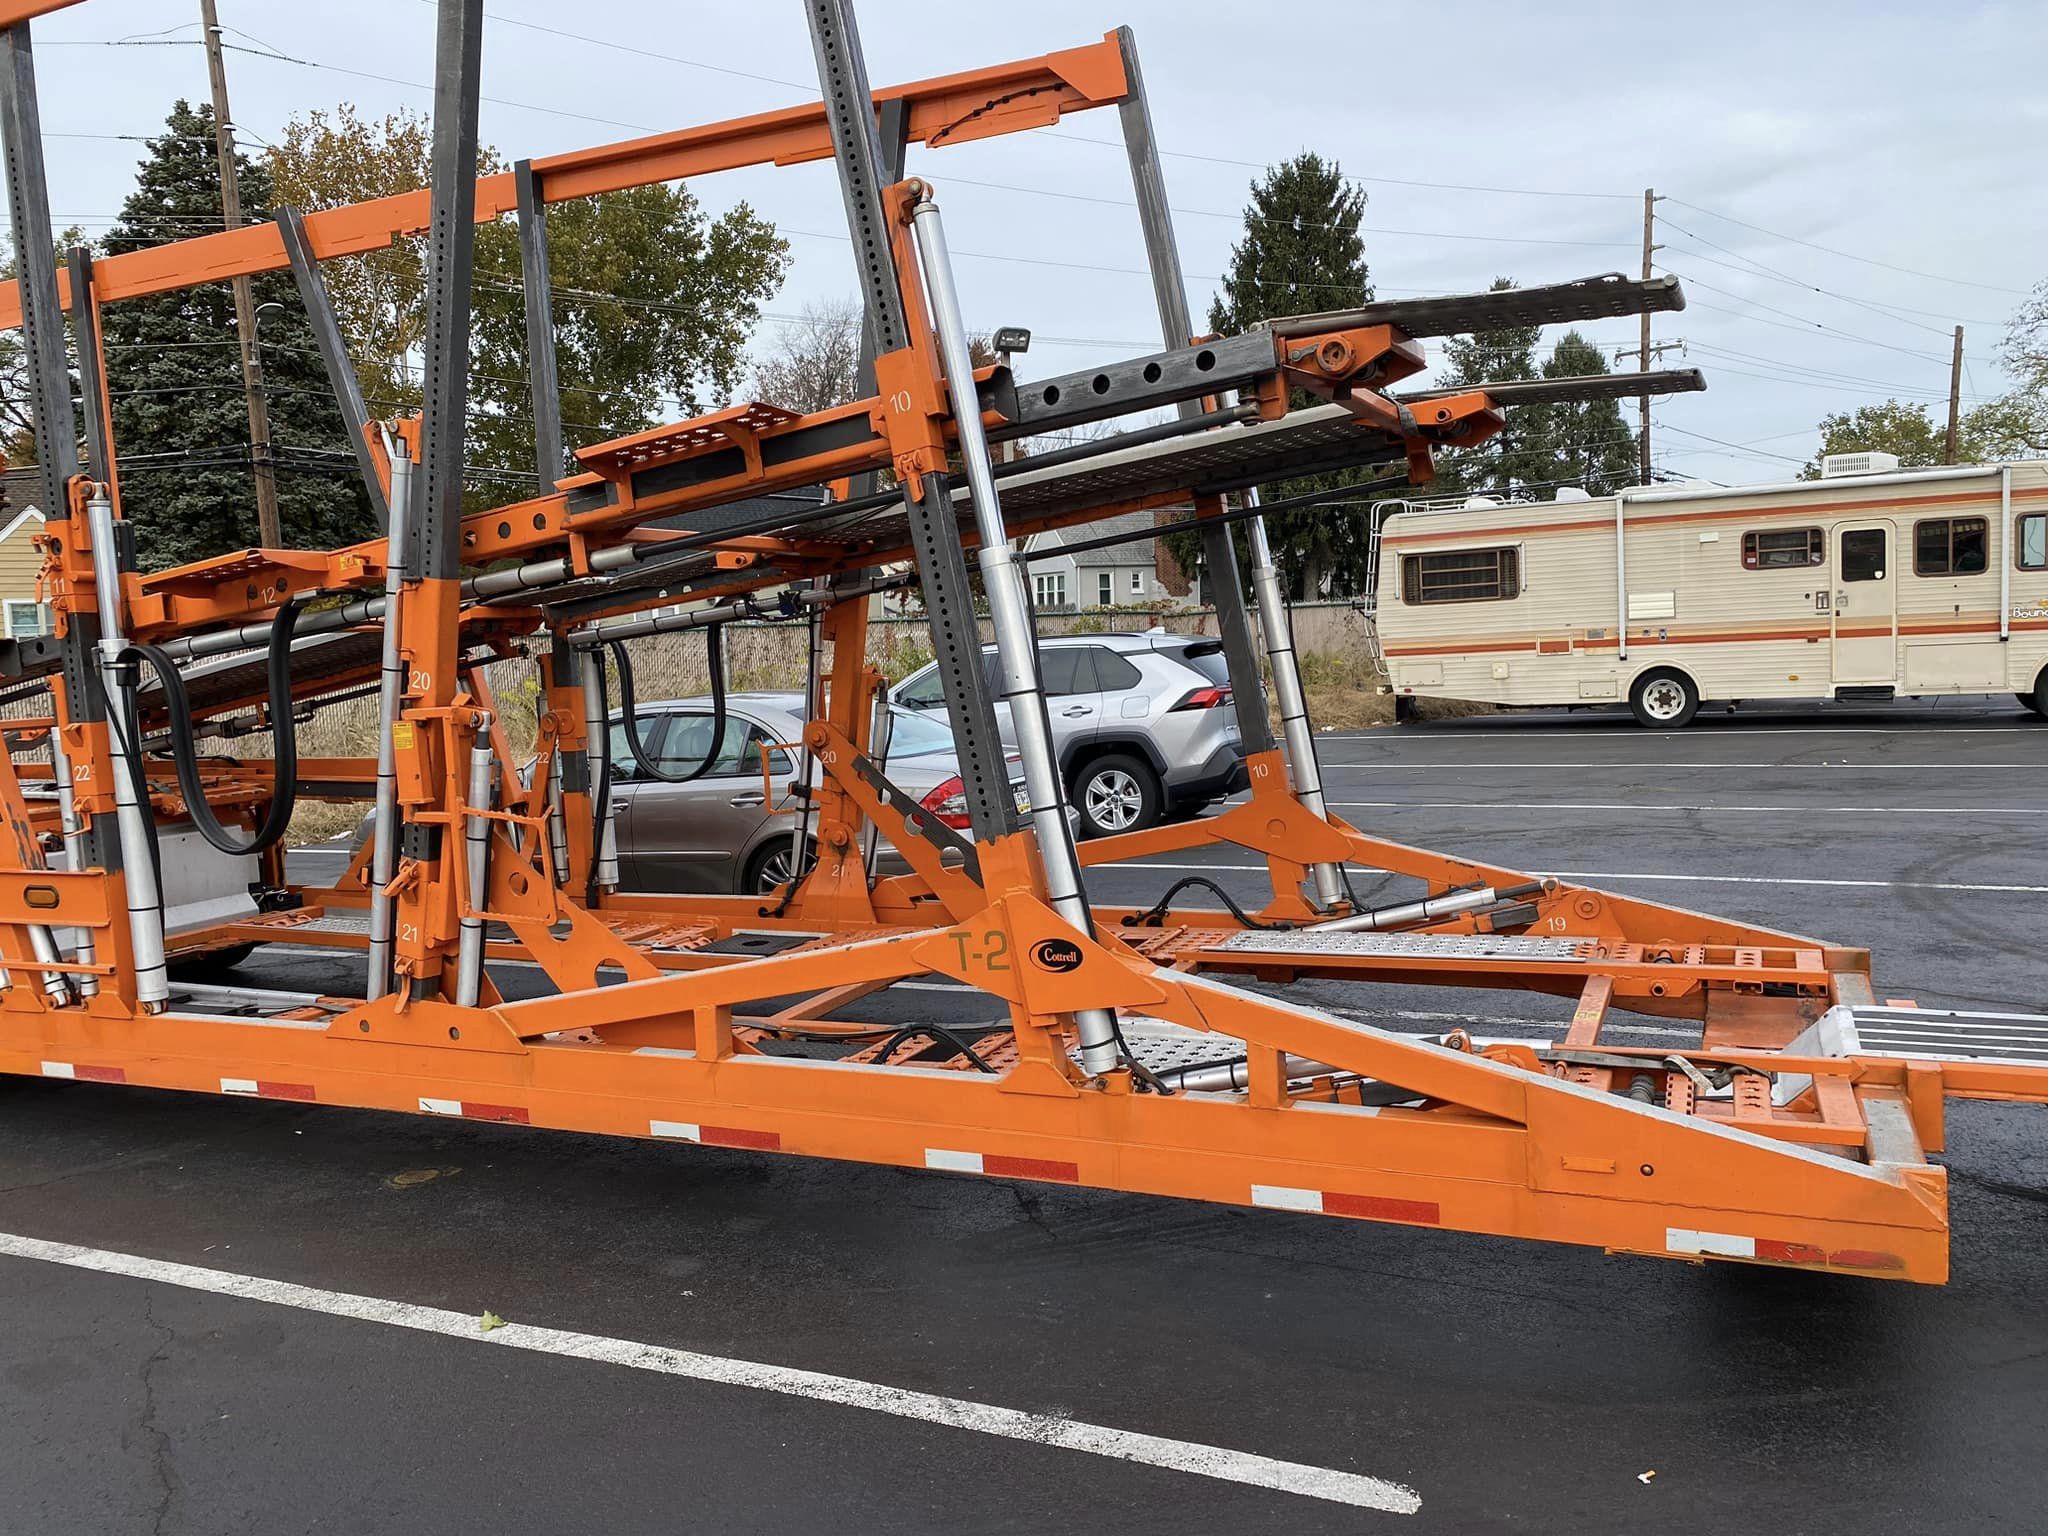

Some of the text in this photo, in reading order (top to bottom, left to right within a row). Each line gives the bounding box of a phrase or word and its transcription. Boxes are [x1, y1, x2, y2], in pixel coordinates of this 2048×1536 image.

[890, 390, 911, 415] 10
[53, 577, 65, 594] 11
[261, 586, 277, 605] 12
[412, 670, 431, 691] 20
[537, 751, 550, 764] 22
[821, 750, 837, 764] 20
[74, 764, 91, 782] 22
[1252, 763, 1269, 778] 10
[832, 864, 846, 878] 21
[1546, 916, 1567, 932] 19
[402, 923, 418, 943] 21
[949, 930, 1010, 972] T-2
[1044, 948, 1077, 962] Cottrell
